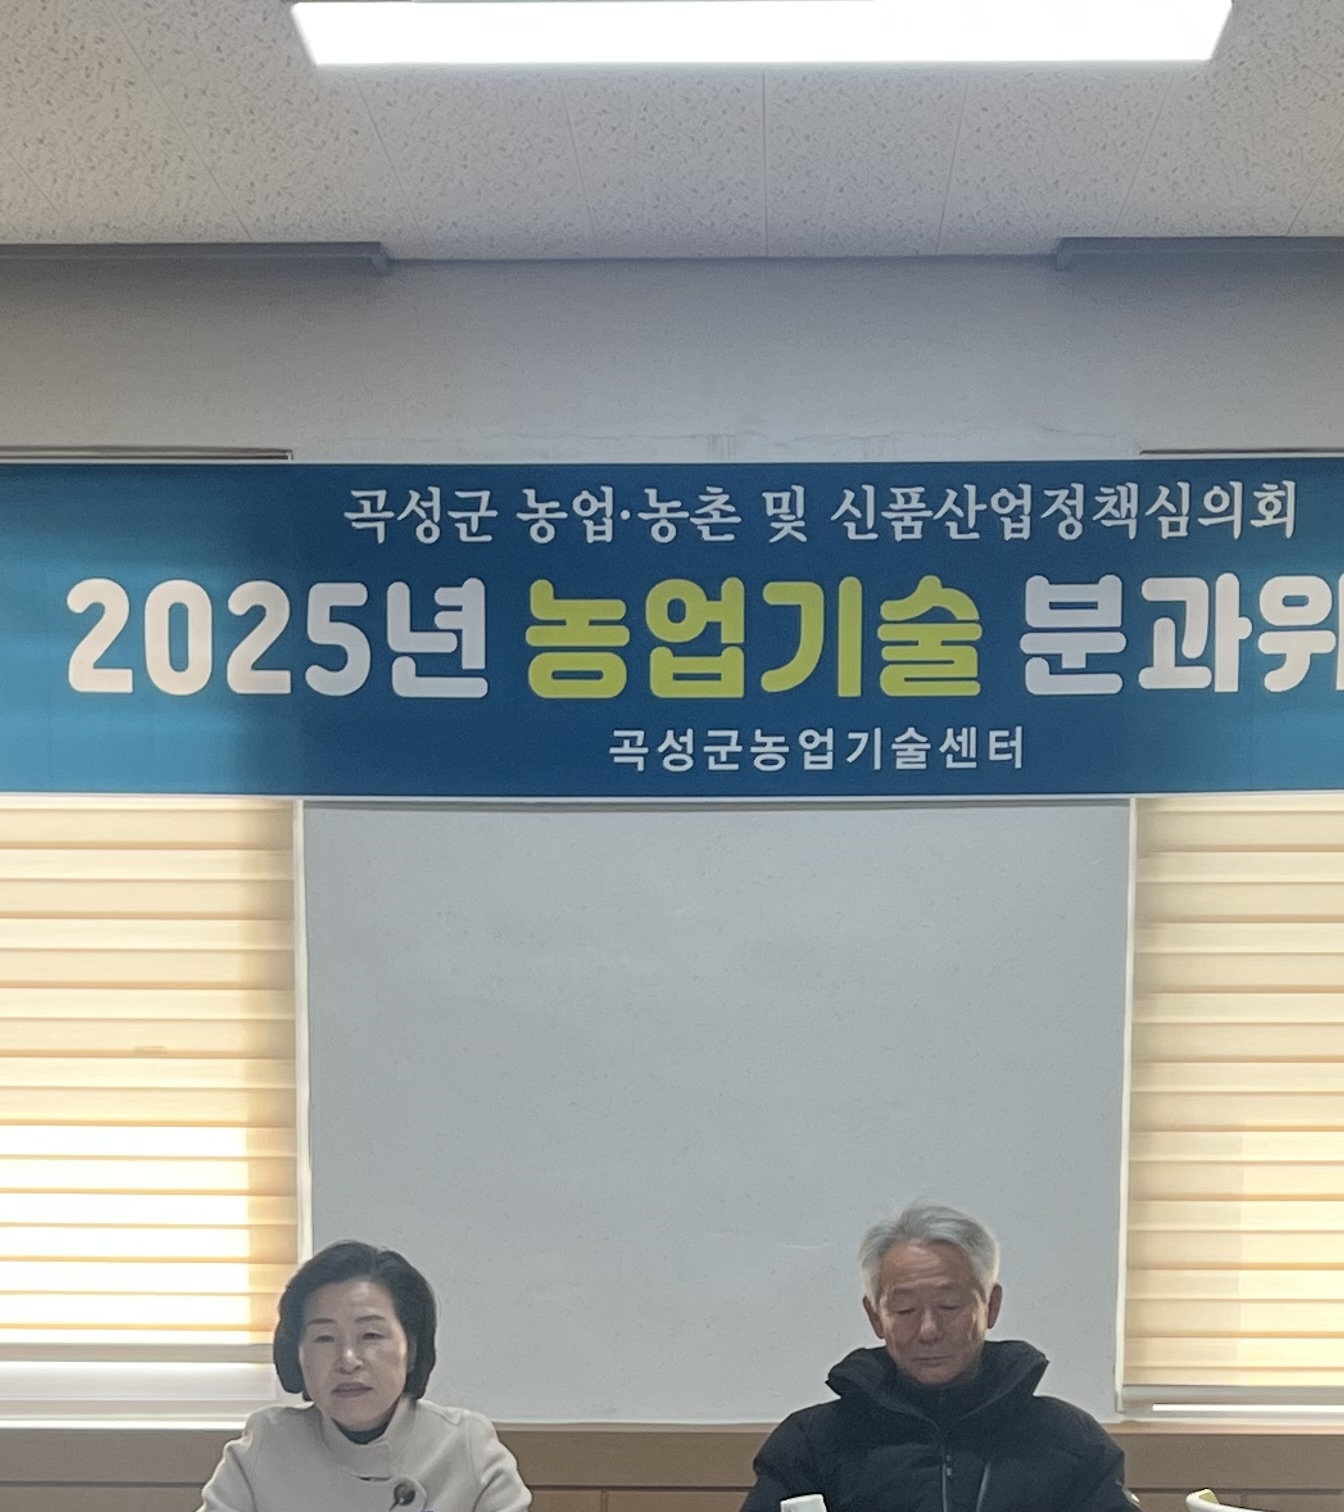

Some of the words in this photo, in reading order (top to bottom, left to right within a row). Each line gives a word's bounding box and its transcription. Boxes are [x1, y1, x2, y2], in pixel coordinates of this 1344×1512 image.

[344, 486, 498, 544] 곡성군
[516, 486, 742, 544] 농업·농촌
[762, 485, 807, 543] 및
[66, 578, 489, 698] 2025년
[525, 575, 983, 699] 농업기술
[609, 726, 1023, 772] 곡성군농업기술센터
